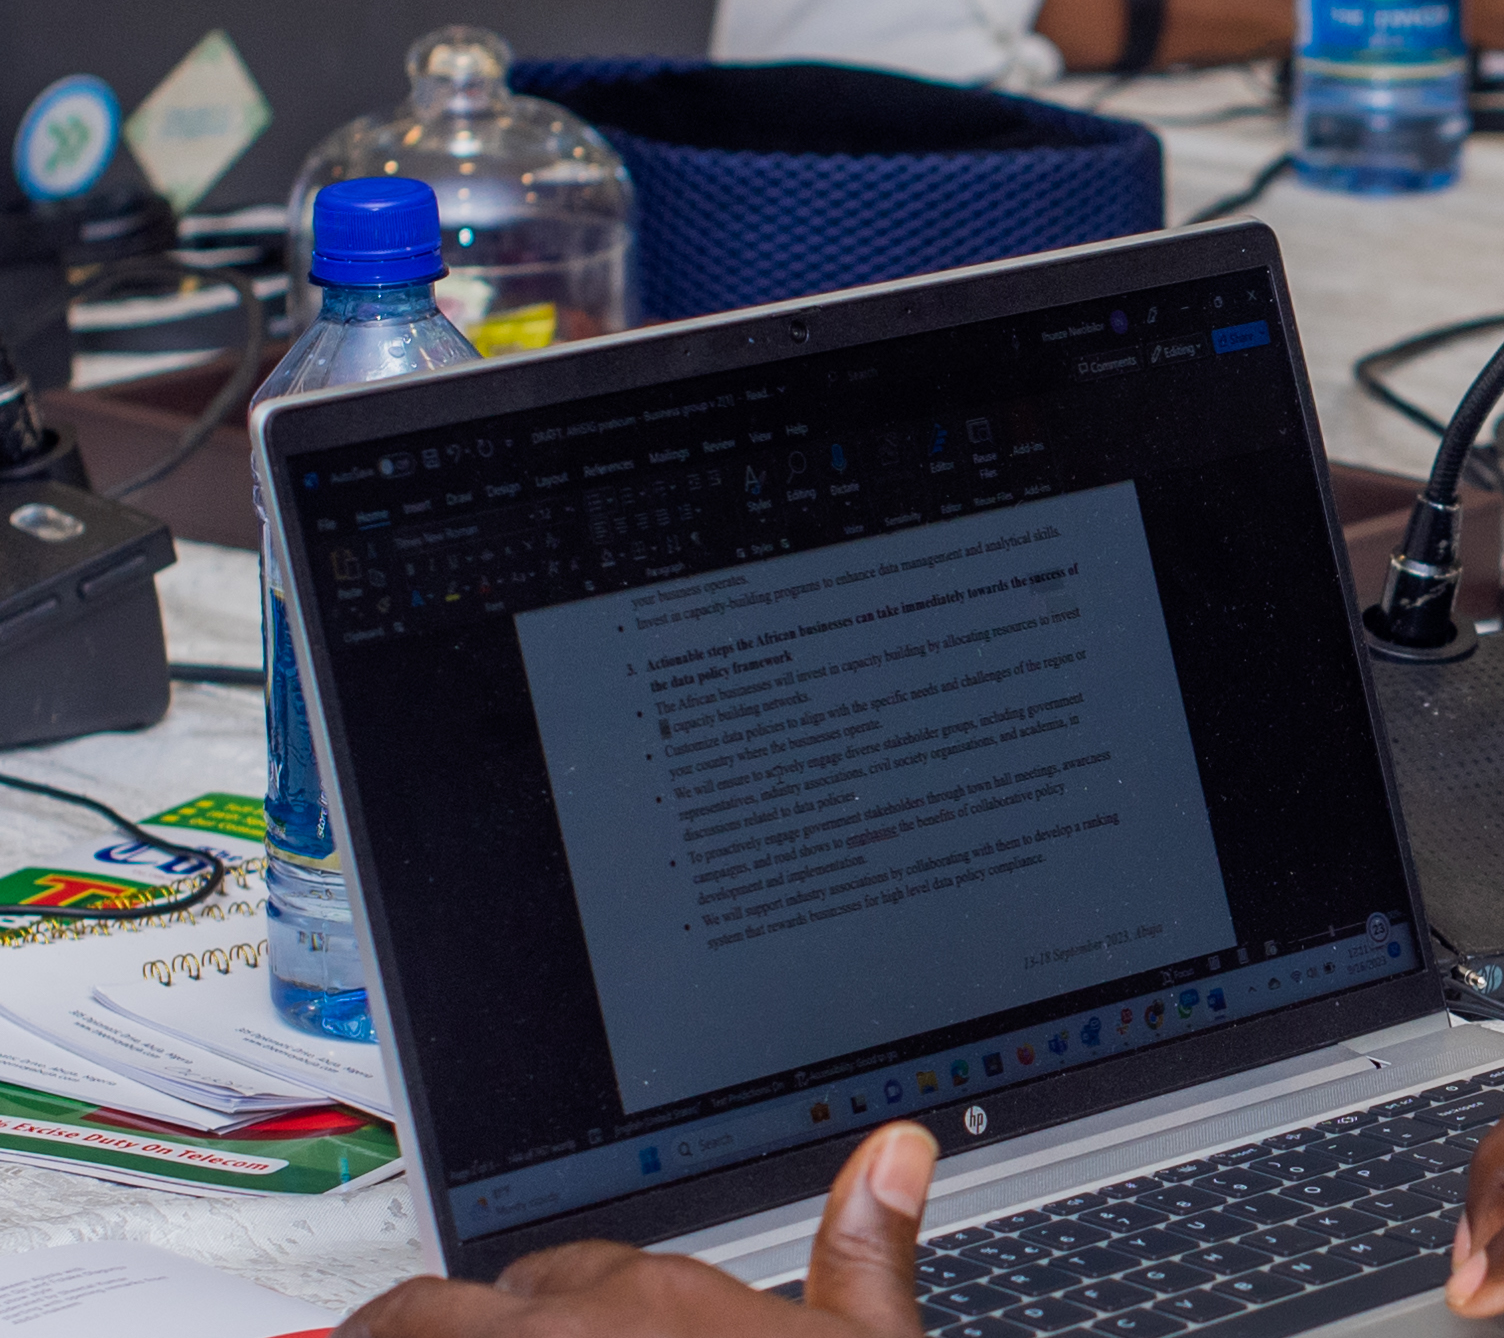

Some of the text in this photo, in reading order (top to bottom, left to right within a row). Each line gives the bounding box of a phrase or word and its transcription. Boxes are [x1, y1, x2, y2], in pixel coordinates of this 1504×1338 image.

[1089, 353, 1138, 375] Comments
[1162, 341, 1197, 362] Editing
[582, 457, 635, 478] References
[647, 445, 691, 467] Mailings
[701, 436, 736, 454] Review
[784, 421, 809, 439] Help
[624, 562, 1080, 676] 3. Actionable steps the African businesses can take immediately towards the success of
[648, 648, 793, 693] the data policy framework
[654, 606, 1081, 715] The African businesses will invest in capacity building by allocating resources to invest
[662, 649, 1088, 758] Customize data policies to align with the specific needs and challenges of the region or
[671, 691, 811, 734] capacity building networks.
[667, 718, 884, 782] your country where the businesses operate.
[671, 785, 692, 800] We
[691, 778, 715, 796] will
[715, 772, 751, 790] ensure
[750, 769, 764, 782] to
[806, 750, 844, 769] engage
[843, 741, 881, 759] diverse
[881, 727, 940, 750] stakeholder
[940, 718, 979, 740] groups,
[978, 707, 1026, 727] including
[1025, 691, 1085, 719] government
[676, 714, 1080, 822] representatives, industry associations, civil society organisations, and academia, in
[1371, 921, 1386, 937] 23
[966, 1107, 985, 1135] hp
[1436, 1101, 1485, 1118] backspace
[11, 1121, 81, 1139] Excise
[82, 1132, 139, 1151] Duty
[141, 1142, 174, 1155] On
[176, 1149, 270, 1172] Telecom
